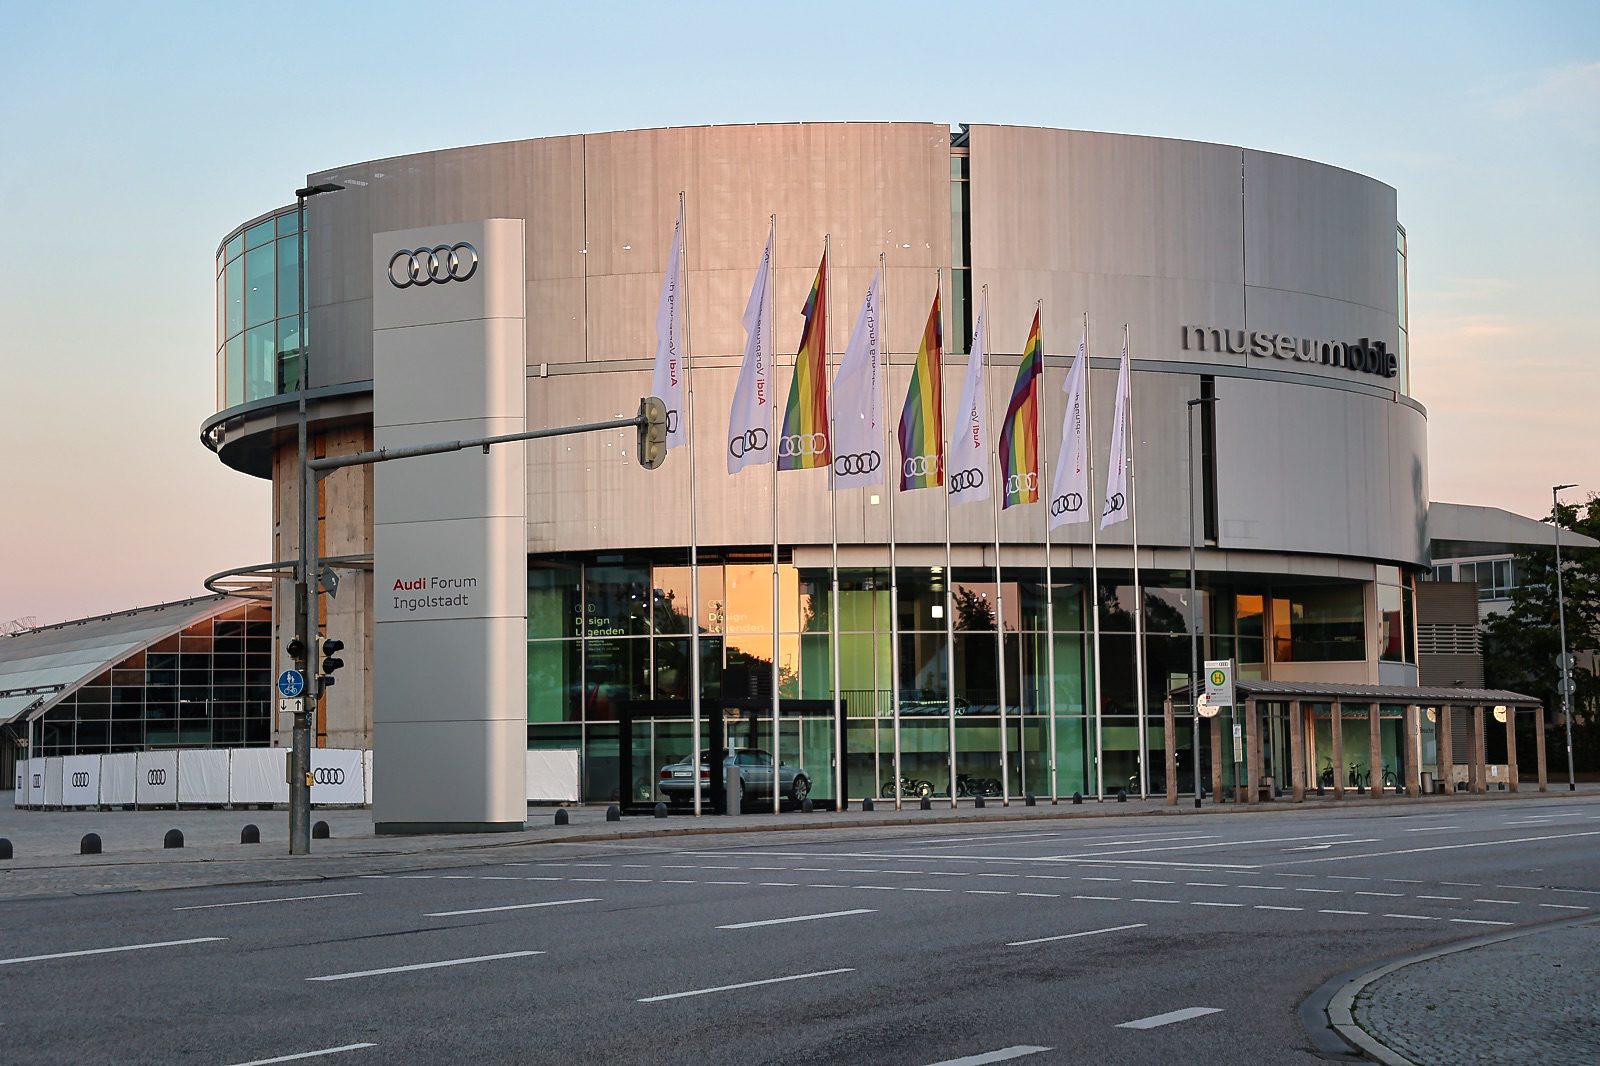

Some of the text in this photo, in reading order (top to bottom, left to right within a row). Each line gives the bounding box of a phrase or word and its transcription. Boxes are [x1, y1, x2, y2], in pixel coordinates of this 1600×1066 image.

[393, 576, 477, 590] Audi Forum
[393, 593, 469, 611] Ingolstadt
[575, 616, 610, 627] Dsign
[575, 627, 625, 638] Lgenden
